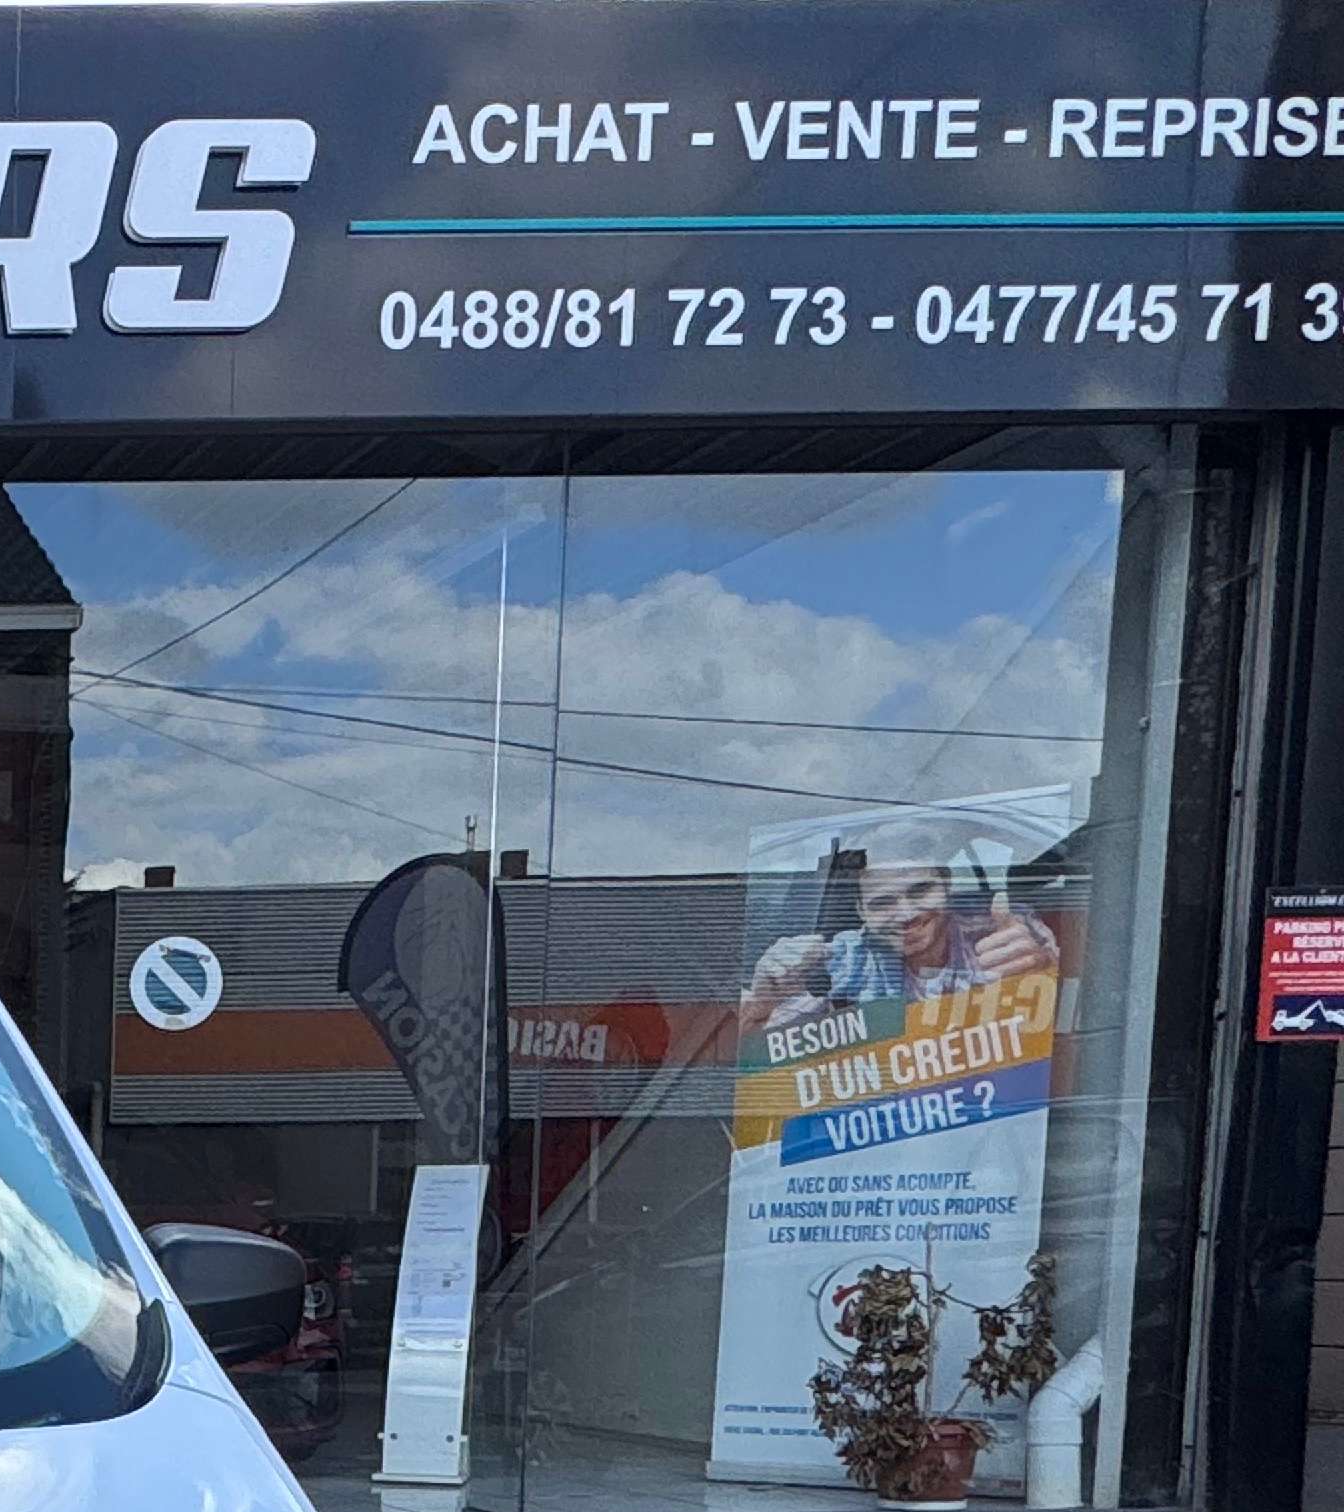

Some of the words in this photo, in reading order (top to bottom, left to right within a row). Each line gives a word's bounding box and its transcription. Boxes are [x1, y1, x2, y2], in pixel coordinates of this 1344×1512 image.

[413, 102, 669, 163] ACHAT
[735, 99, 980, 160] VENTE
[381, 288, 635, 349] 0488/81
[669, 288, 745, 345] 72
[771, 287, 846, 345] 73
[916, 283, 1177, 344] 0477/45
[1202, 283, 1271, 341] 71
[1302, 283, 1344, 341] 3
[766, 1009, 868, 1064] BESOIN
[794, 1051, 884, 1108] D'UN
[889, 1015, 1025, 1085] CRÉDIT
[825, 1088, 968, 1151] VOITURE
[973, 1081, 996, 1117] ?
[749, 1203, 766, 1219] LA
[770, 1202, 827, 1219] MAISON
[832, 1202, 851, 1218] DU
[855, 1198, 892, 1218] PRÊT
[898, 1199, 939, 1217] VOUS
[944, 1196, 1018, 1216] PROPOSE
[786, 1176, 824, 1194] AVEC
[828, 1176, 849, 1193] OU
[852, 1174, 892, 1192] SANS
[769, 1226, 794, 1244] LES
[798, 1225, 890, 1243] MEILLEURES
